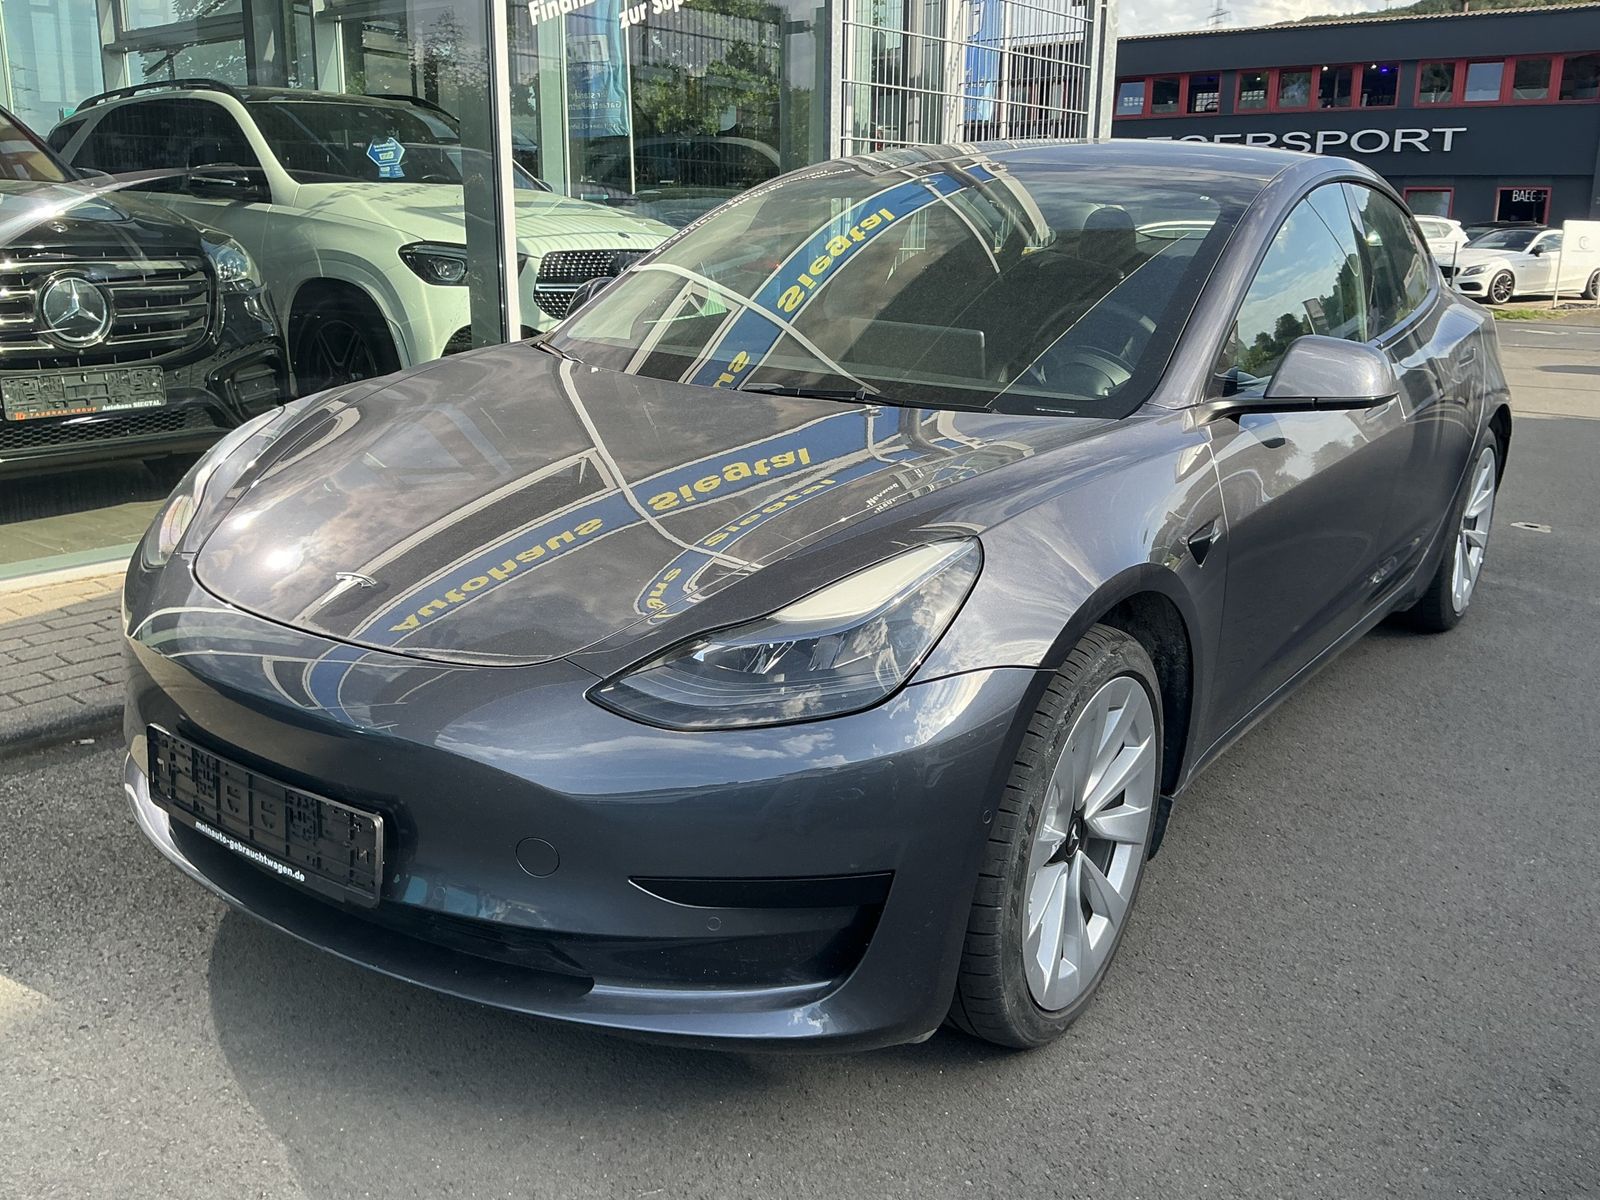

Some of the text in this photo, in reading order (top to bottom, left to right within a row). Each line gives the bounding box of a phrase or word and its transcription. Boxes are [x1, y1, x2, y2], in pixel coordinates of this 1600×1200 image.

[618, 0, 692, 30] zur Sup
[133, 399, 162, 408] SIEGTAL
[194, 819, 306, 883] meinauto-gebrauchtwagen.de
